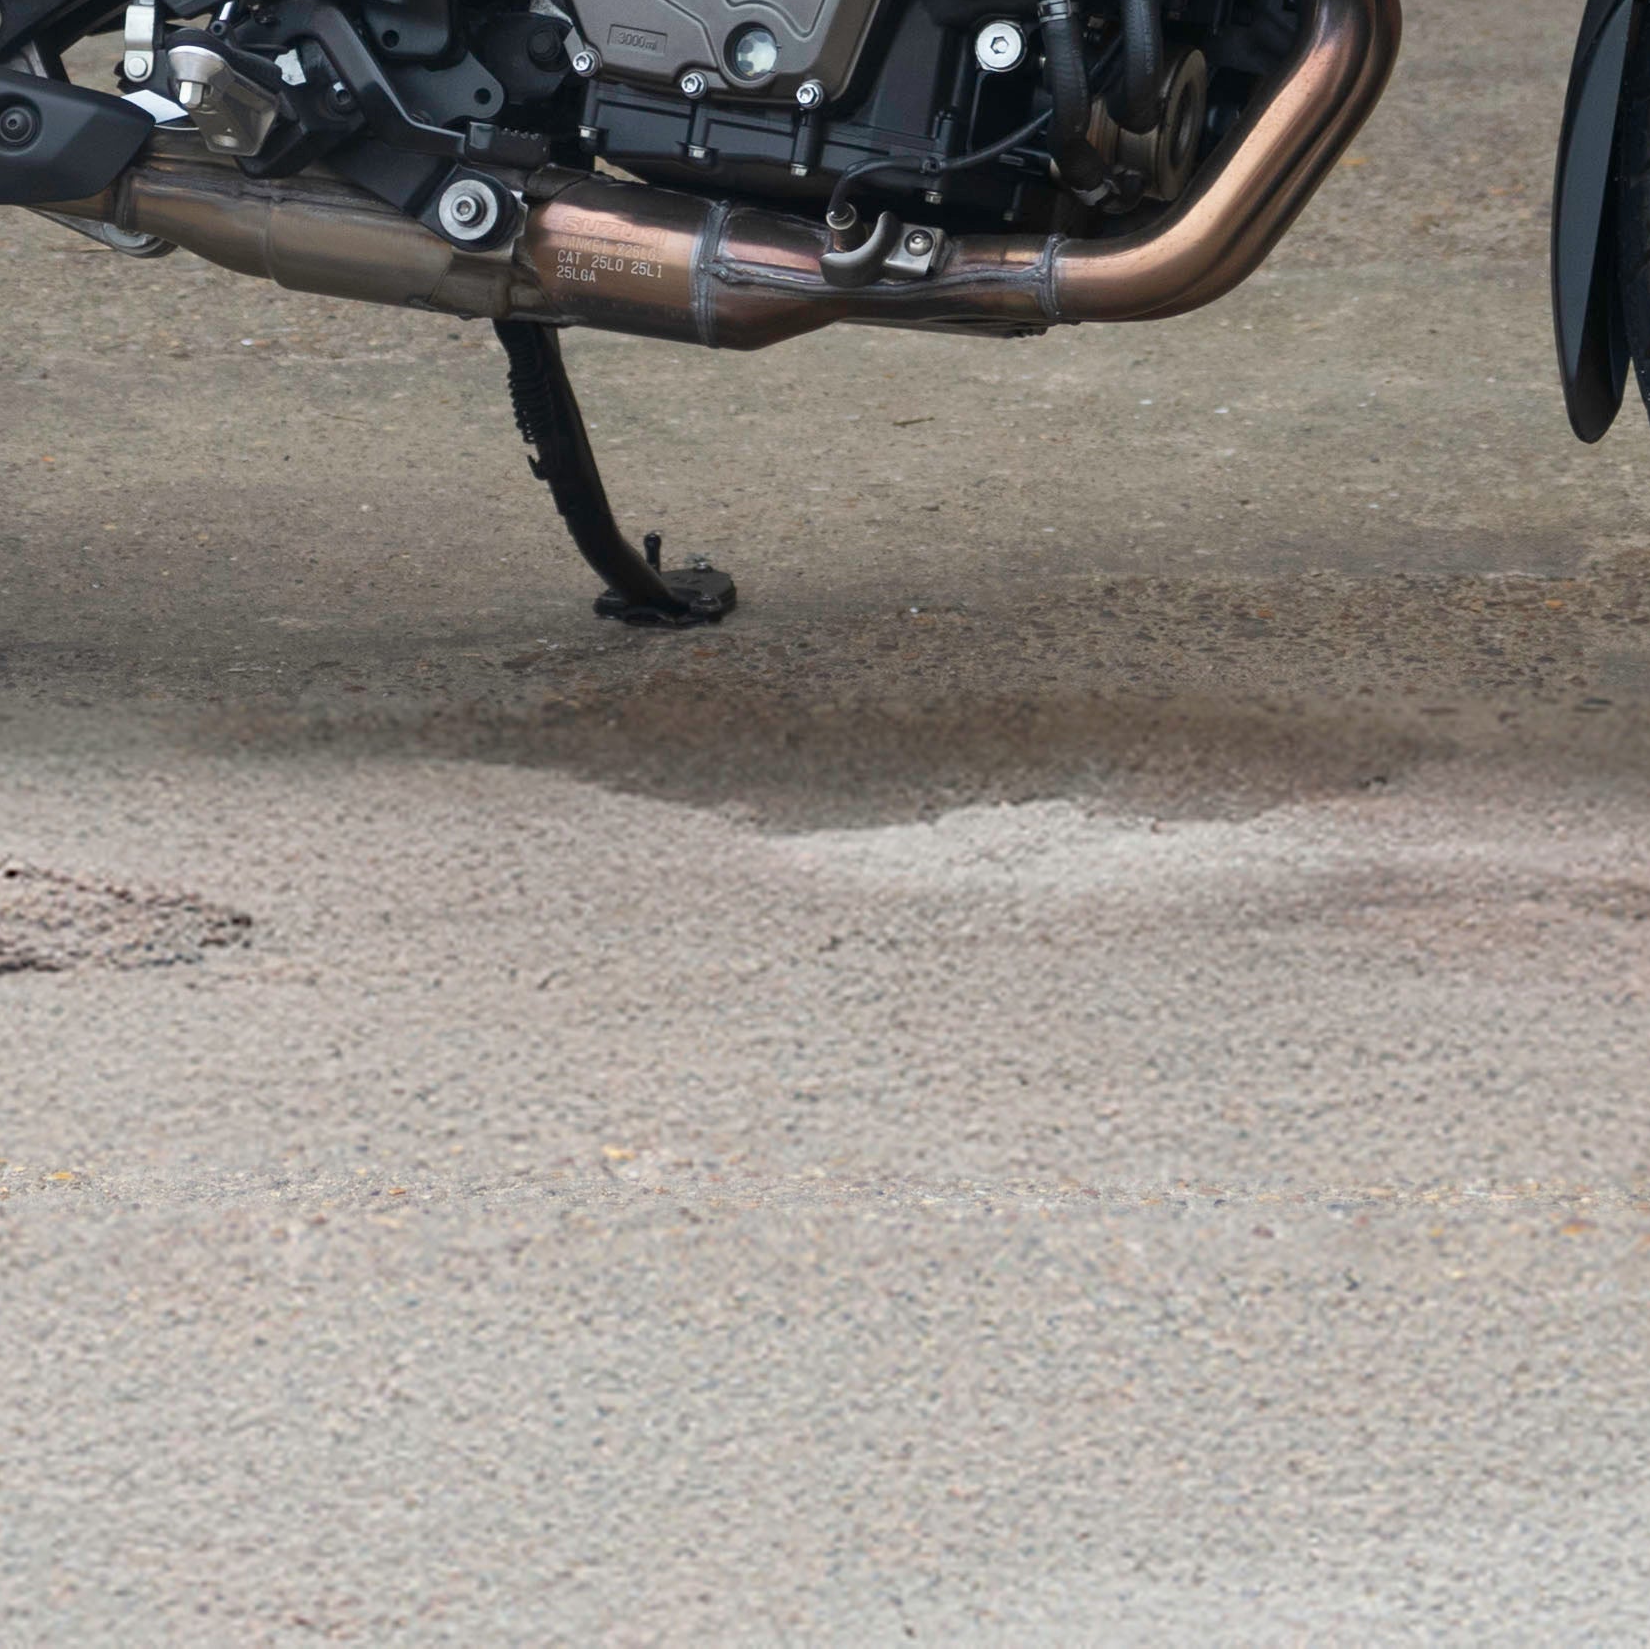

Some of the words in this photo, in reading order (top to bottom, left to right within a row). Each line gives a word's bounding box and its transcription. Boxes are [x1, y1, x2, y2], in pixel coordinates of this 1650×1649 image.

[564, 215, 669, 245] SUZUKI
[556, 264, 597, 283] 25LGA
[557, 249, 582, 265] CAT
[630, 261, 663, 279] 25L1
